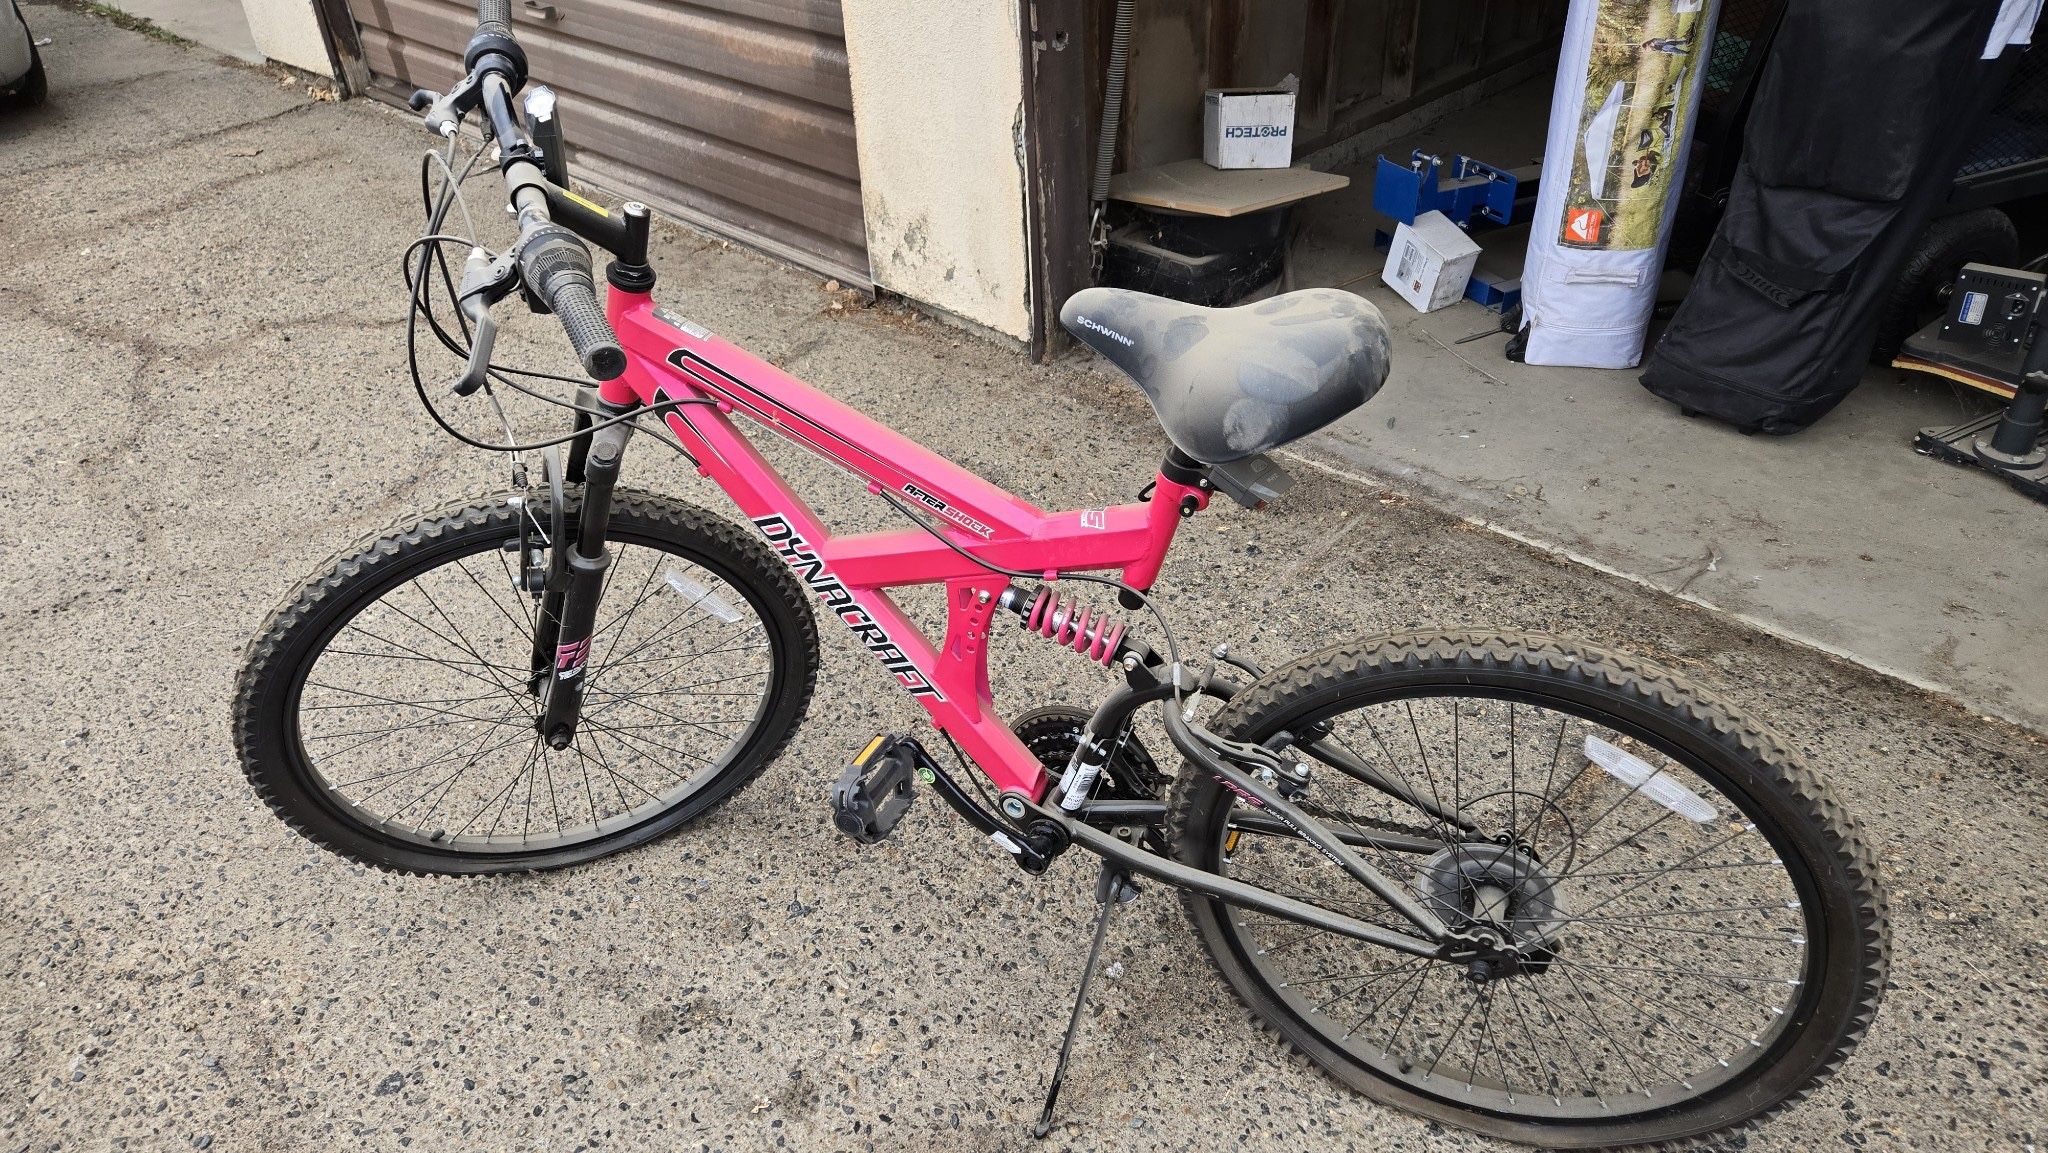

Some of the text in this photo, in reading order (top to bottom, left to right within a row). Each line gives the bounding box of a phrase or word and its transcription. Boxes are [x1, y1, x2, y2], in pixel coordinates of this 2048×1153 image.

[1226, 126, 1287, 138] PROTECH
[1077, 316, 1133, 347] SCHWINN
[752, 512, 948, 702] DYNACRAFT
[1263, 806, 1284, 821] LINEAR
[1283, 819, 1297, 831] PULL
[1297, 830, 1322, 850] BRAKING
[1321, 848, 1345, 867] SYSTEM
